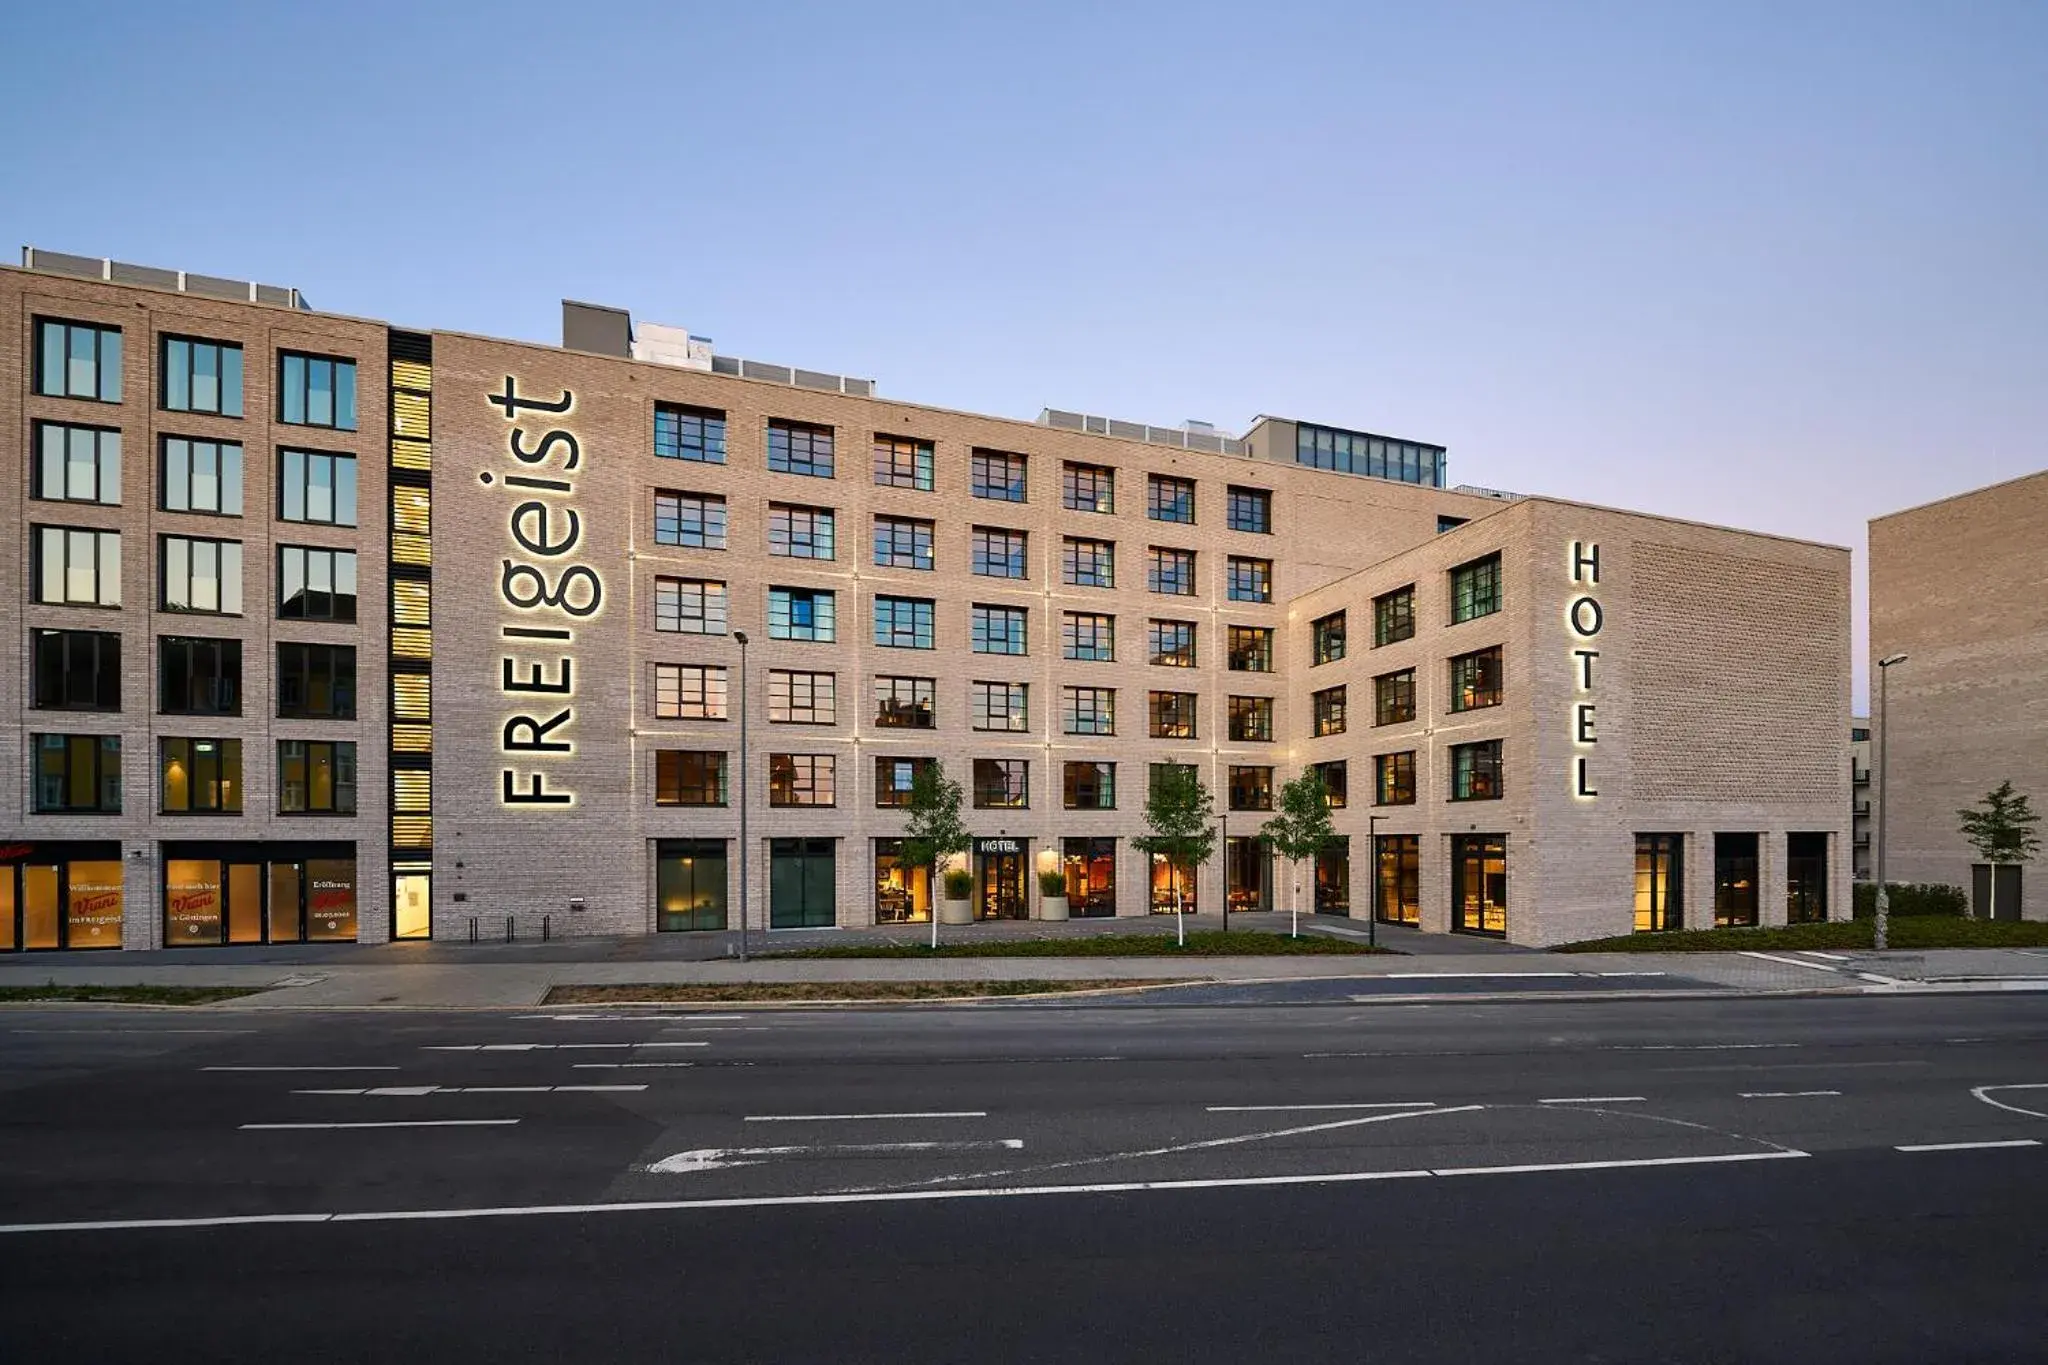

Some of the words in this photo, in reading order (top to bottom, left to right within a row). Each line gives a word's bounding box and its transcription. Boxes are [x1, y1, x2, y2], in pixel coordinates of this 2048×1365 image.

[479, 375, 601, 803] FREIgeist
[1570, 541, 1603, 797] HOTEL
[981, 840, 1020, 852] HOTEL
